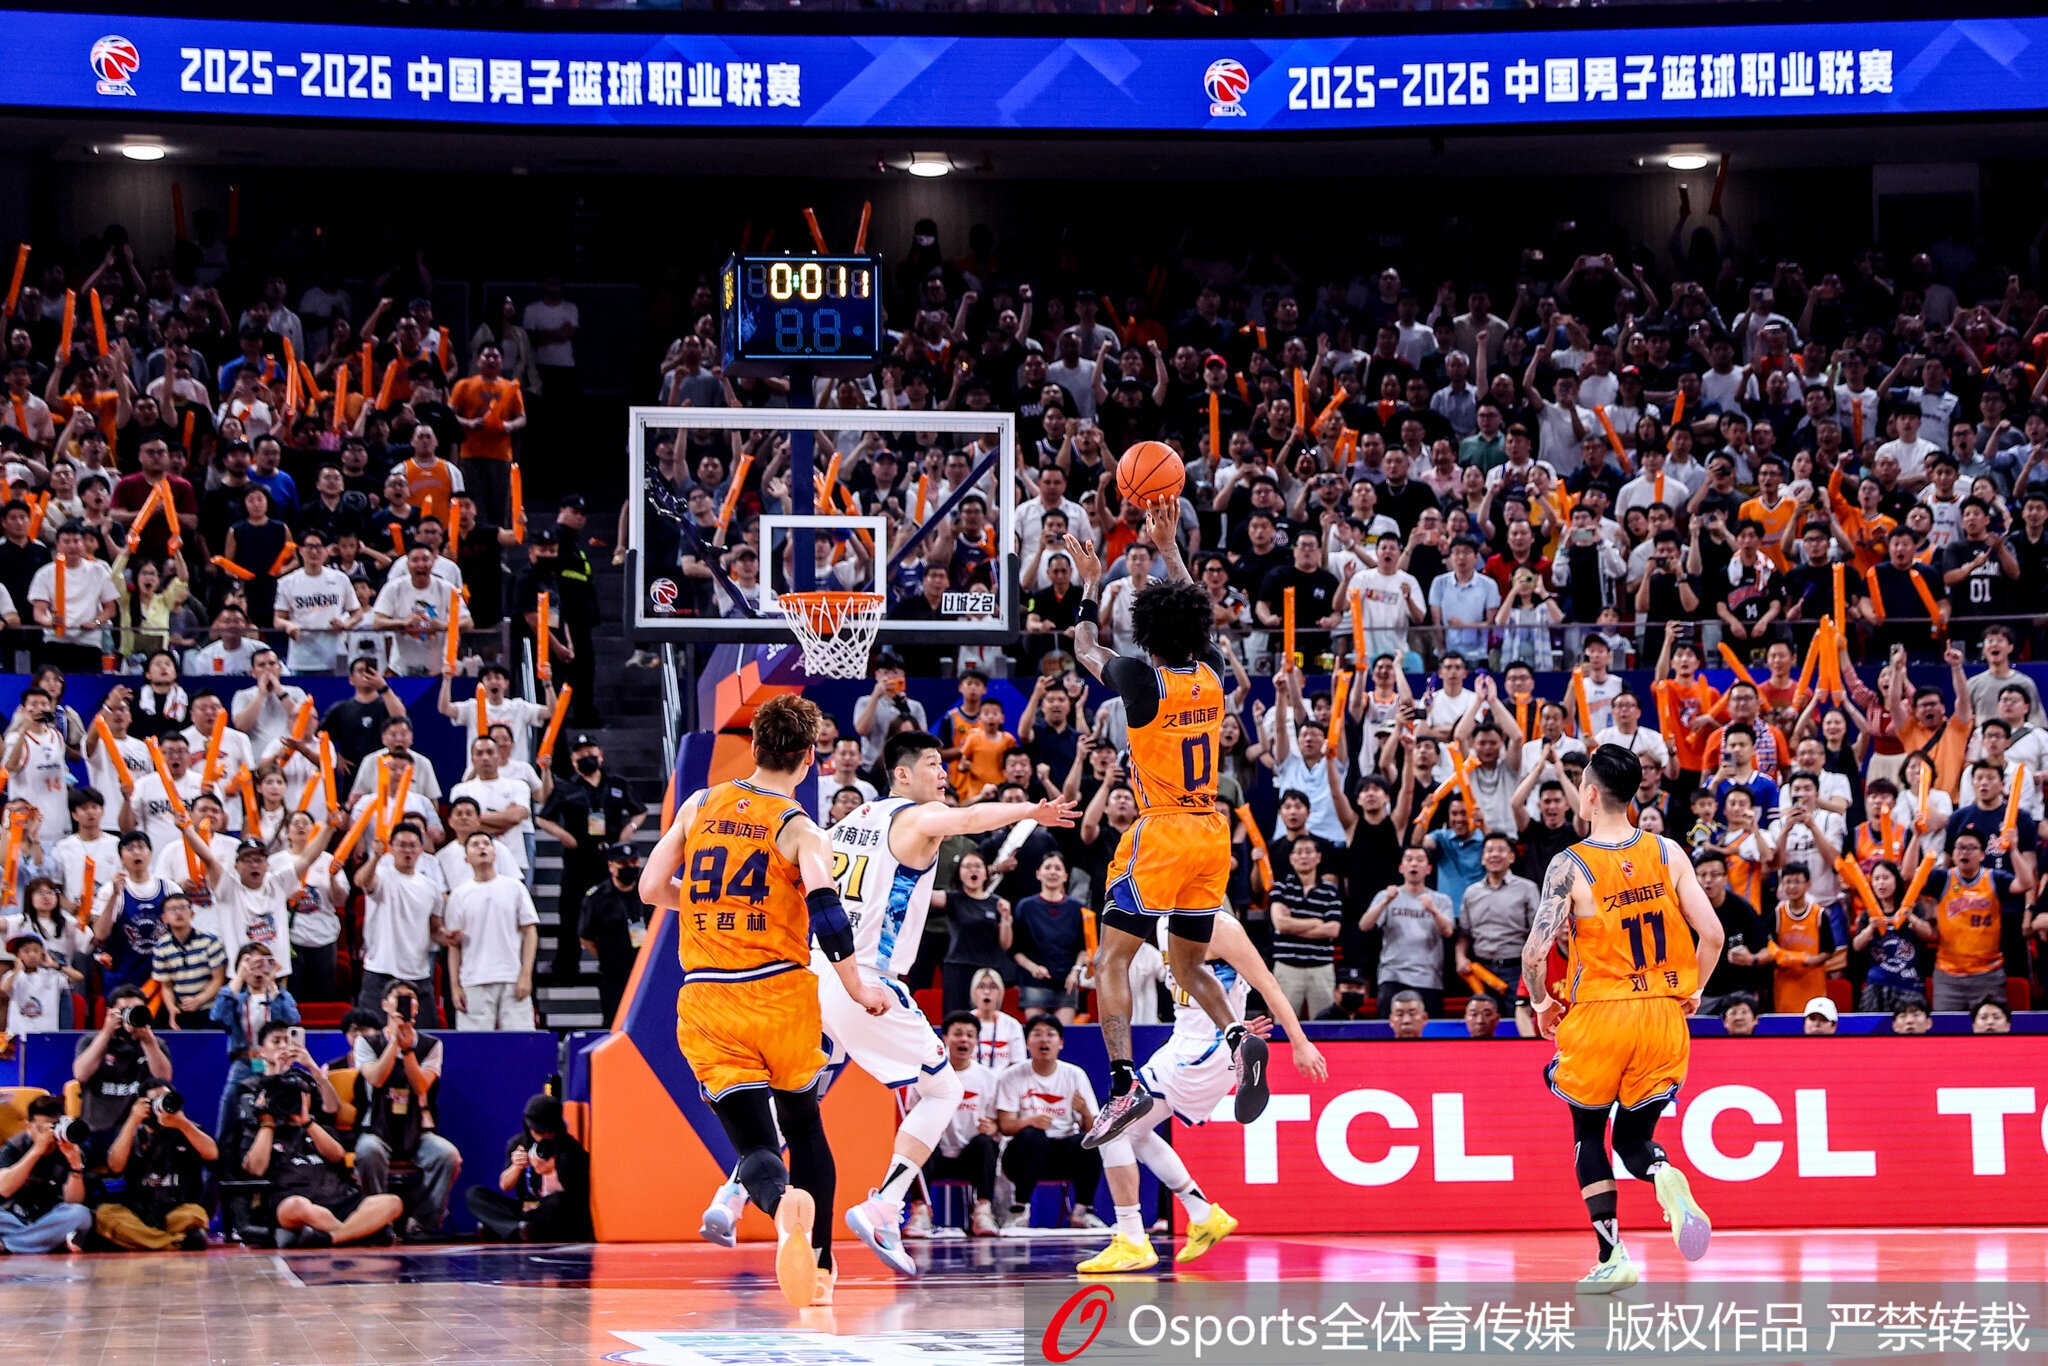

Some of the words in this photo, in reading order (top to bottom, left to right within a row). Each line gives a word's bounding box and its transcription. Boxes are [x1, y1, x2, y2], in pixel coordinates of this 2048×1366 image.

[181, 47, 391, 98] 2025-2026
[408, 56, 800, 107] 中国男子篮球职业联赛
[1289, 61, 1489, 109] 2025-2026
[1505, 49, 1893, 103] 中国男子篮球职业联赛
[944, 595, 993, 612] 以城之名
[1970, 578, 1992, 603] 01
[1162, 706, 1218, 729] 久事体育
[1182, 732, 1211, 792] 0
[701, 820, 768, 841] 久事体育
[689, 846, 770, 905] 94
[832, 851, 869, 903] 21
[1603, 882, 1666, 912] 久事体育
[693, 912, 767, 932] 王哲林
[1621, 910, 1667, 971] 11
[1629, 970, 1679, 993] 刘铮
[1210, 1088, 1515, 1187] TCL
